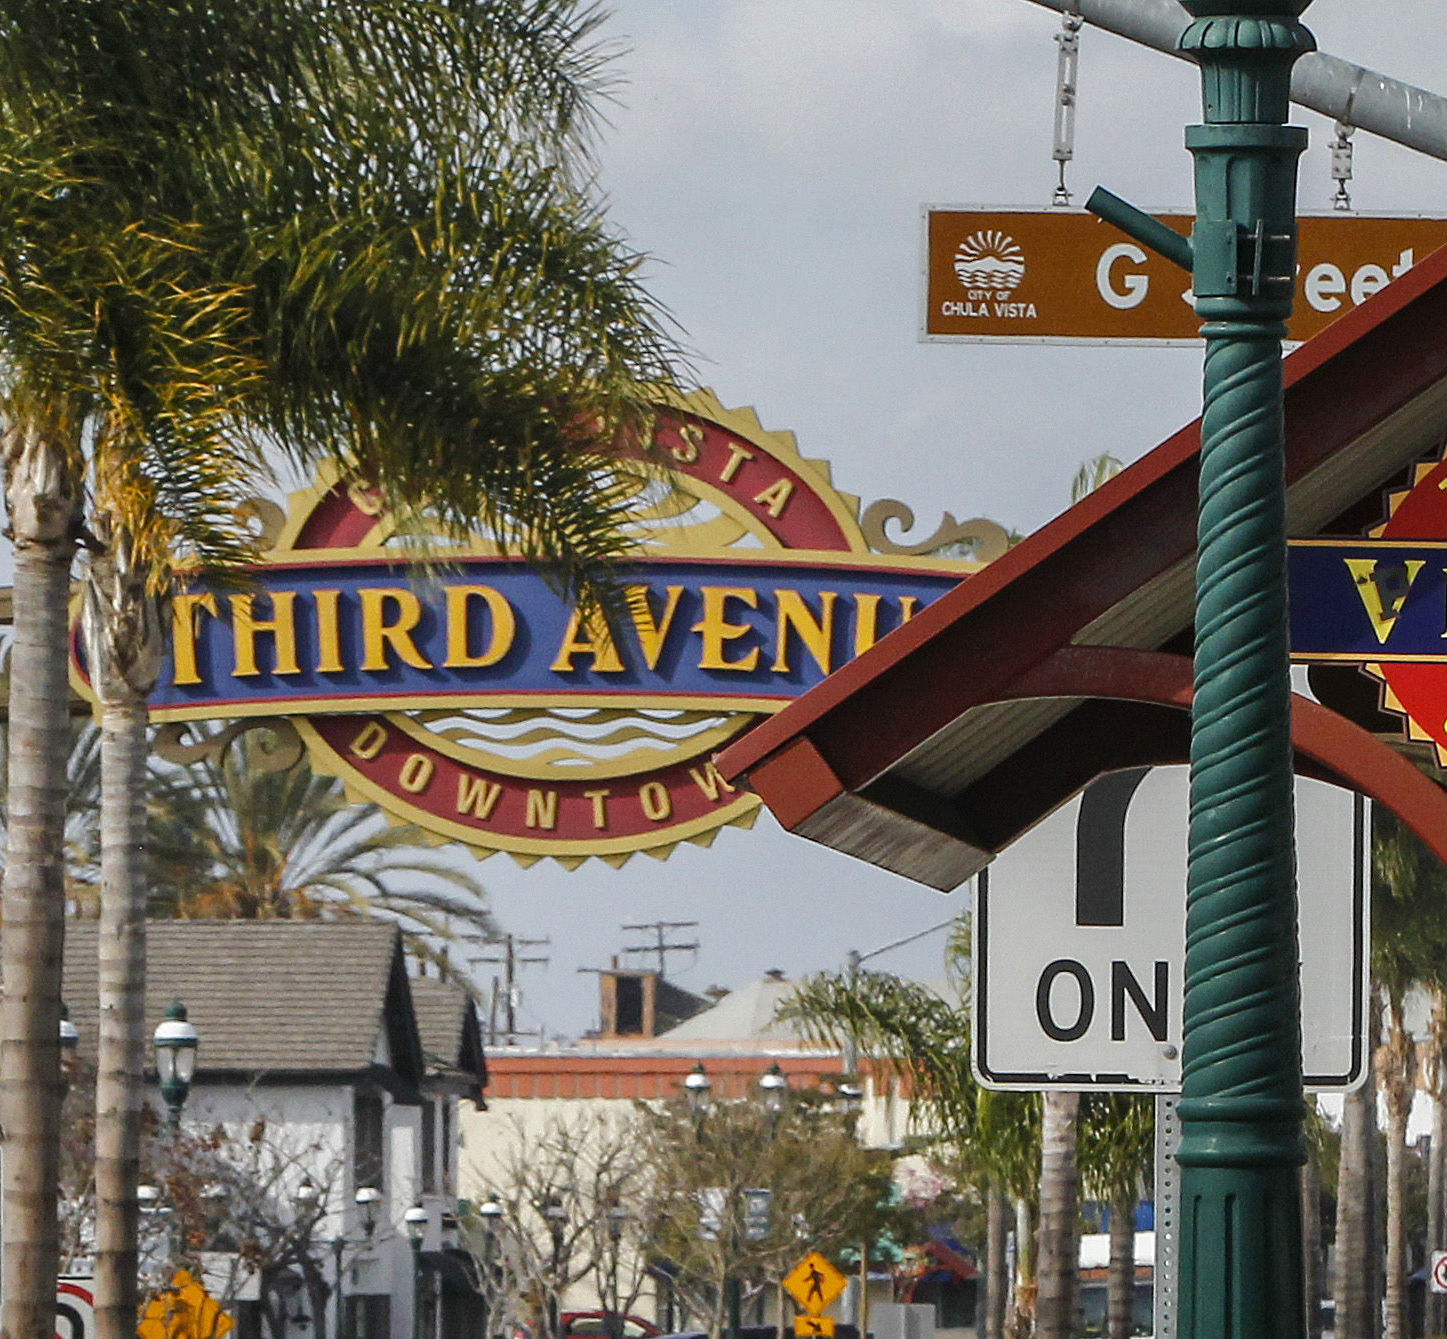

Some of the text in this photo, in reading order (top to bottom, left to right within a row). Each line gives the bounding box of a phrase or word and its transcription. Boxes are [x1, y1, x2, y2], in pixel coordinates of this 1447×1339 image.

[941, 302, 1038, 318] CHULA VISTA
[967, 289, 1011, 301] CITY OF
[1095, 242, 1149, 311] G
[171, 582, 919, 686] THIRD AVENU
[349, 720, 736, 830] DOWNTOW
[1035, 959, 1169, 1043] ON
